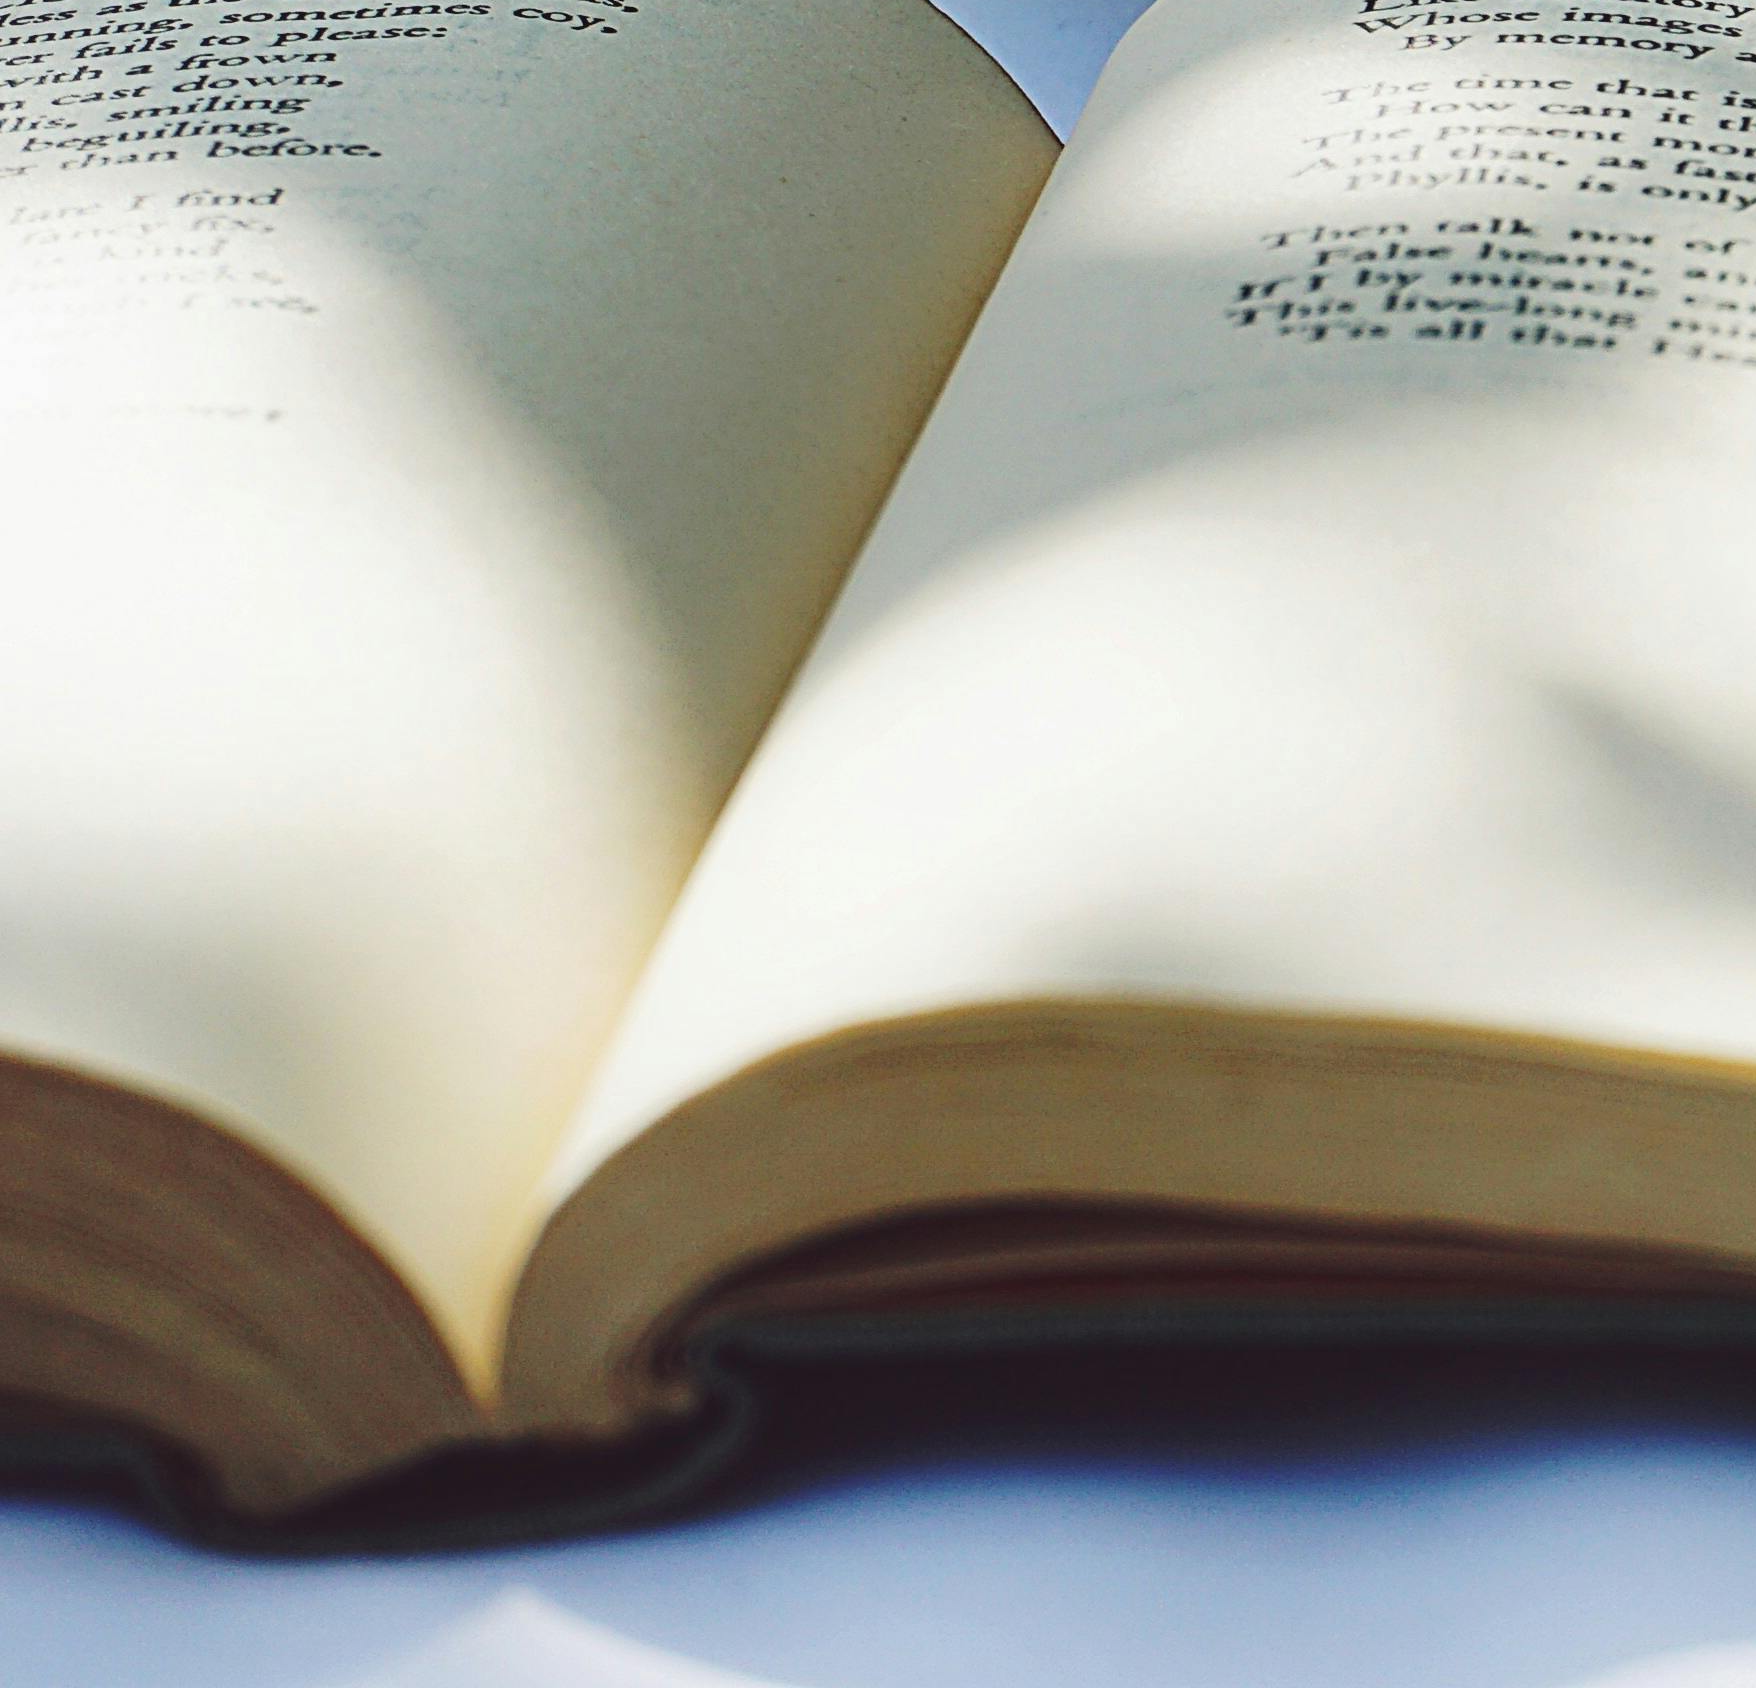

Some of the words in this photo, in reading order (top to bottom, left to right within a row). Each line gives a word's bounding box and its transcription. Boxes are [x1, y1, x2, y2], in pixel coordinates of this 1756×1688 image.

[96, 0, 149, 16] as
[219, 2, 492, 25] sometimes
[1353, 10, 1541, 35] Whose
[1560, 6, 1744, 39] images
[70, 35, 180, 60] fails
[199, 34, 250, 47] to
[266, 26, 449, 48] please:
[1400, 32, 1474, 52] By
[1495, 32, 1717, 60] memory
[125, 64, 155, 76] a
[174, 52, 337, 72] frown
[51, 84, 153, 106] cast
[171, 73, 344, 94] down,
[1319, 80, 1433, 105] The
[1453, 73, 1575, 91] time
[1596, 78, 1700, 102] that
[106, 94, 312, 123] smiling
[1375, 99, 1514, 118] How
[1538, 102, 1634, 120] can
[1658, 106, 1697, 126] it
[1301, 127, 1415, 151] The
[1436, 123, 1629, 144] present
[59, 148, 180, 172] than
[206, 137, 383, 159] before.
[1289, 144, 1425, 179] And
[1596, 154, 1650, 171] as
[174, 186, 286, 208] find
[1577, 174, 1617, 194] is
[1260, 222, 1410, 250] Then
[1682, 238, 1753, 257] of
